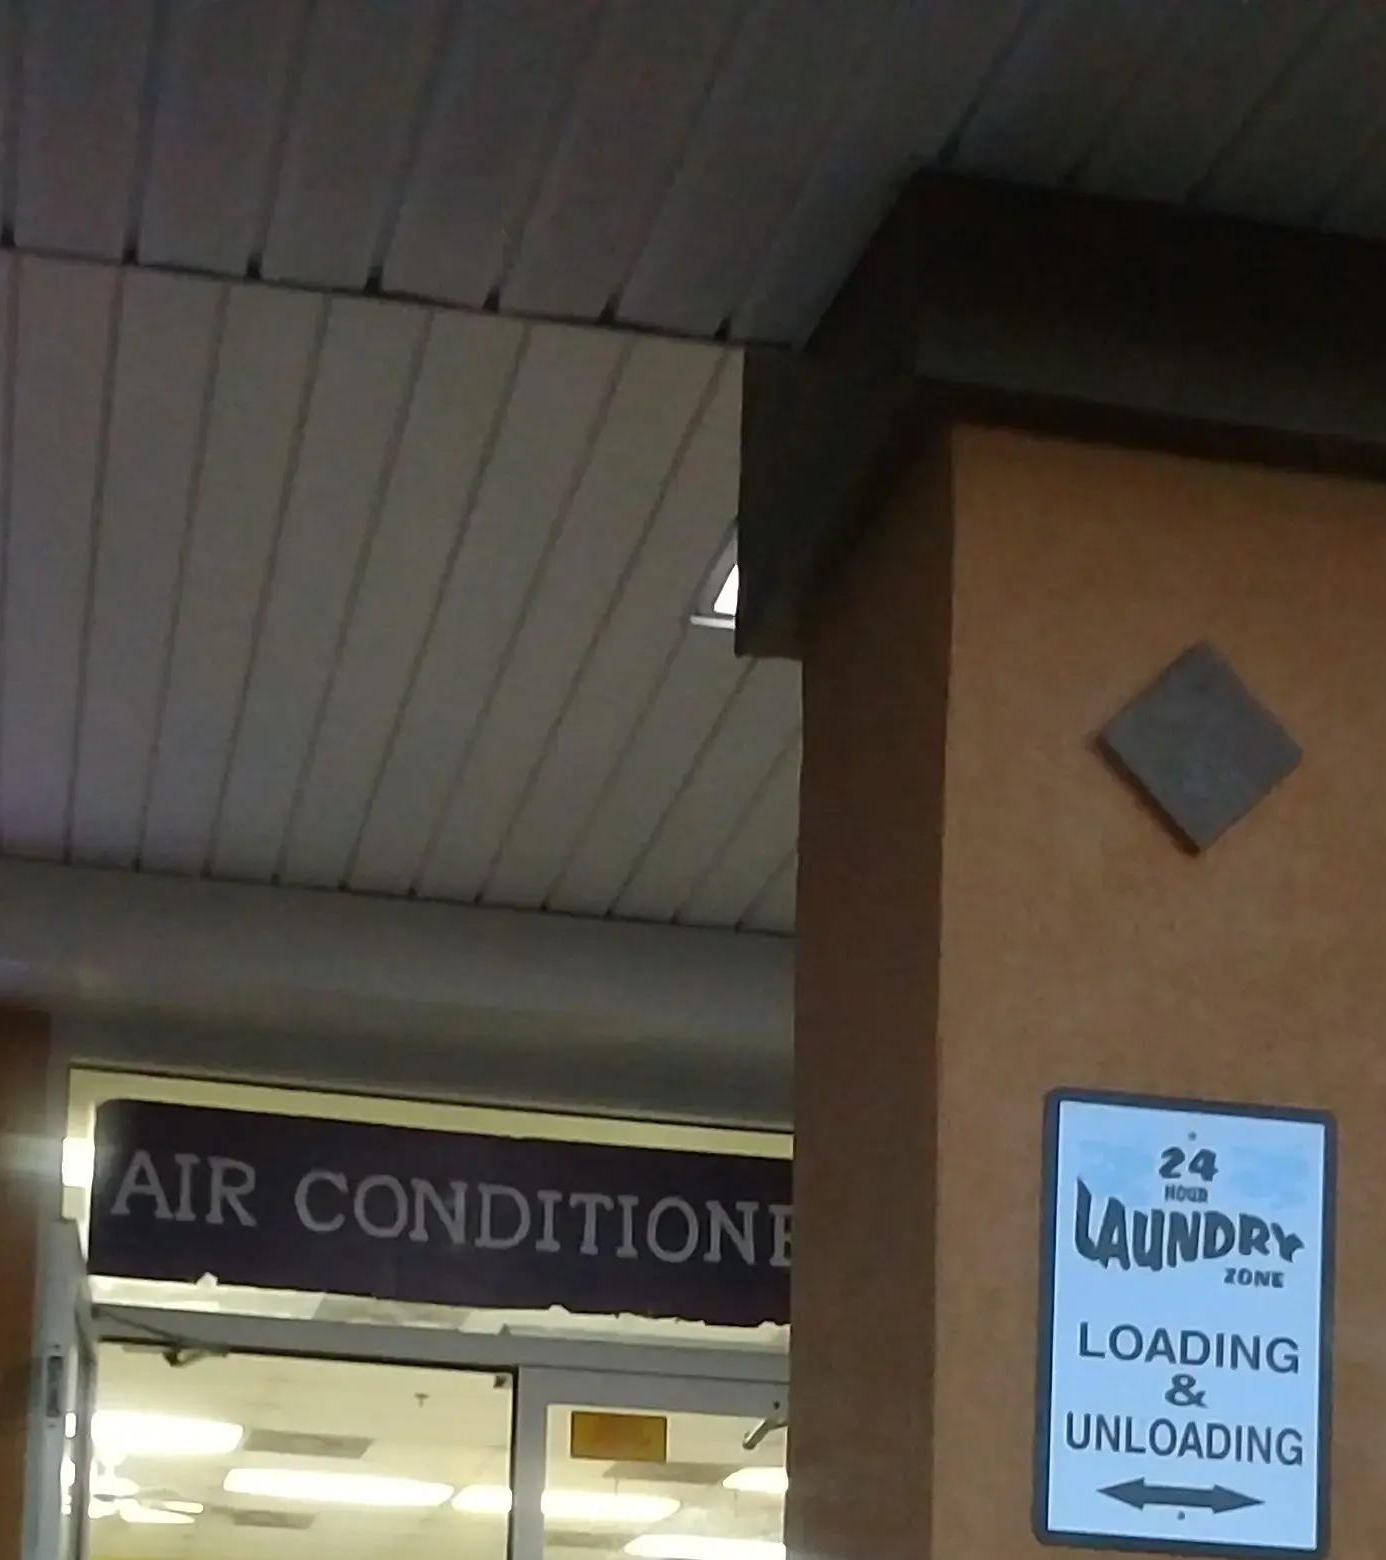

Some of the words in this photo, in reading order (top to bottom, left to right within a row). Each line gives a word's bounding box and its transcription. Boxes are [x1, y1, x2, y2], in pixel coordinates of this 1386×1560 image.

[1158, 1146, 1219, 1182] 24
[110, 1149, 258, 1227] AIR
[1164, 1184, 1209, 1203] HOUR
[1073, 1177, 1305, 1272] LAUNDRY
[1223, 1267, 1285, 1289] ZONE
[1078, 1321, 1300, 1374] LOADING
[1164, 1373, 1207, 1409] &
[1065, 1411, 1303, 1466] UNLOADING
